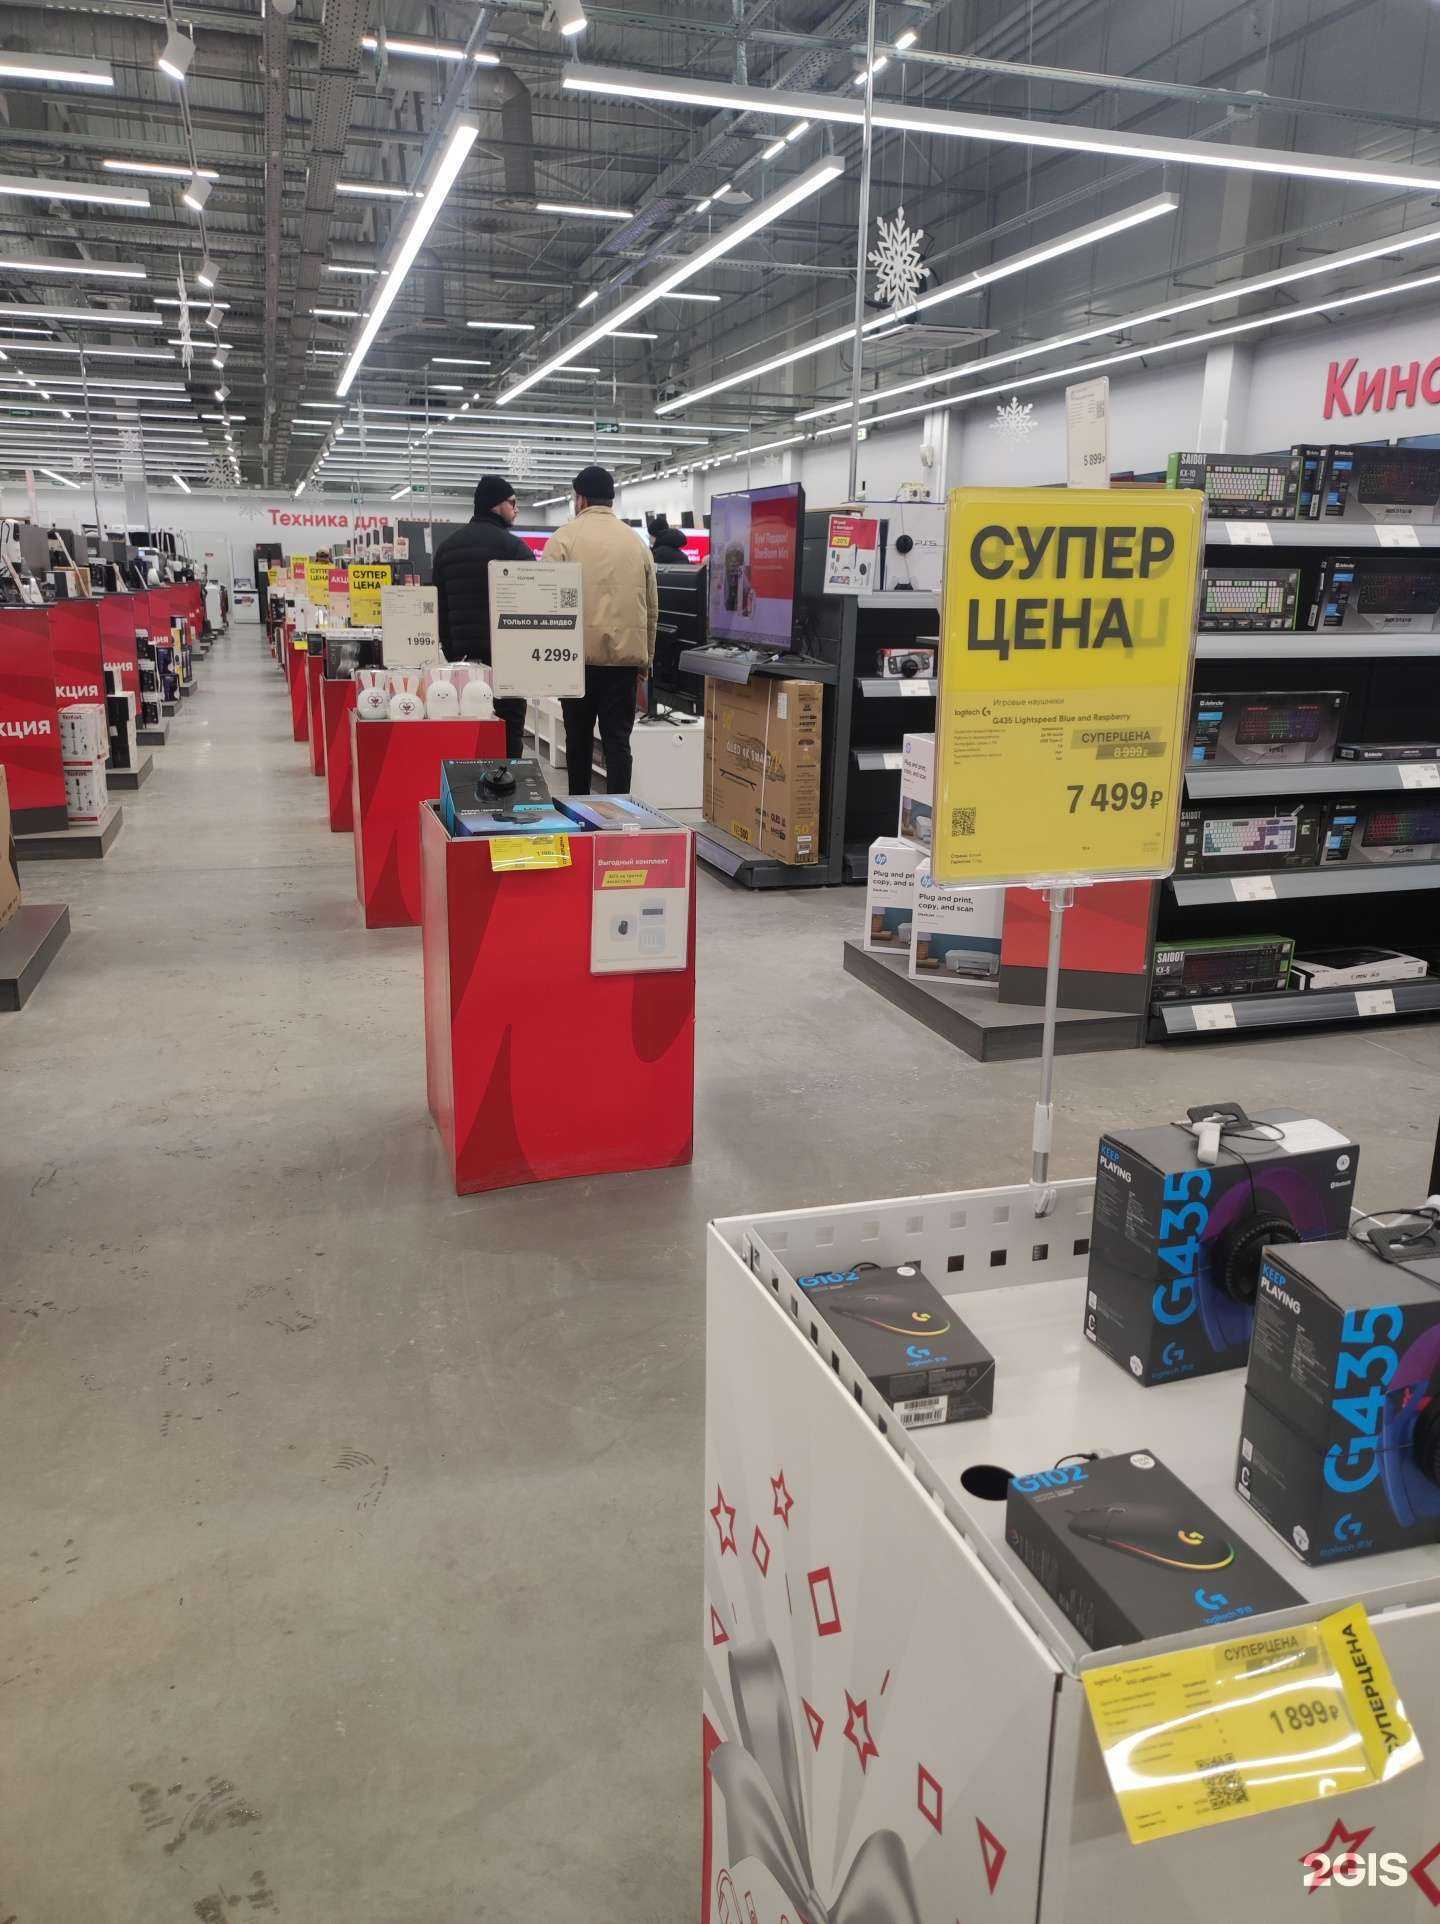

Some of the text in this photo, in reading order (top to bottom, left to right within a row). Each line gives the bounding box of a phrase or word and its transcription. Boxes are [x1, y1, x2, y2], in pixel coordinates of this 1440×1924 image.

[268, 509, 390, 531] Техника для
[969, 525, 1175, 581] СУПЕР
[353, 570, 388, 579] СУПЕР
[353, 581, 381, 590] ЦЕНА
[967, 598, 1134, 661] ЦЕНА
[954, 709, 980, 718] logitech
[993, 712, 1131, 725] G435 Lightspeed Blue and Raspberry
[1081, 730, 1151, 744] СУПЕРЦЕНА
[598, 858, 634, 866] Выгодный
[873, 870, 888, 878] Plug
[894, 879, 907, 887] and
[918, 902, 974, 913] copy, and scan
[919, 893, 974, 905] Plug and print,
[1101, 1143, 1120, 1162] KEEP
[1100, 1154, 1132, 1182] PLAYING
[1152, 1168, 1212, 1326] G435
[798, 1271, 860, 1288] G102
[1262, 1264, 1287, 1287] KEEP
[1260, 1276, 1301, 1314] PLAYING
[1324, 1305, 1405, 1493] G435
[1012, 1464, 1089, 1493] G102
[1224, 1635, 1298, 1661] СУПЕРЦЕНА
